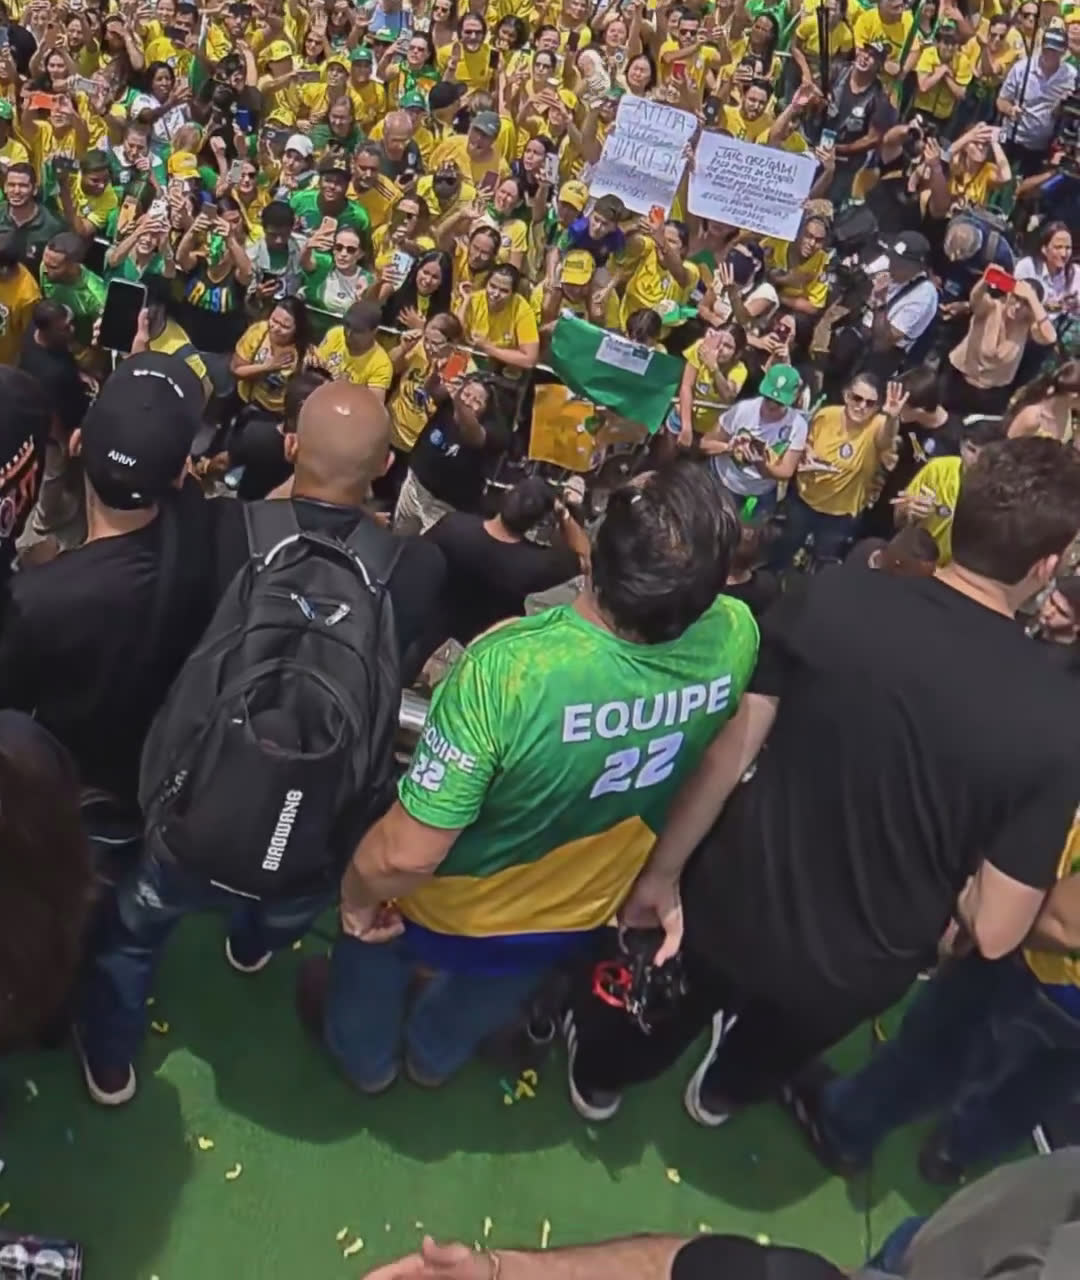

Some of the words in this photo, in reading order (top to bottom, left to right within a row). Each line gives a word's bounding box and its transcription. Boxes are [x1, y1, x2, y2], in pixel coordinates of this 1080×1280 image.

[562, 674, 732, 743] EQUIPE
[410, 752, 446, 791] 22
[589, 731, 684, 800] 22
